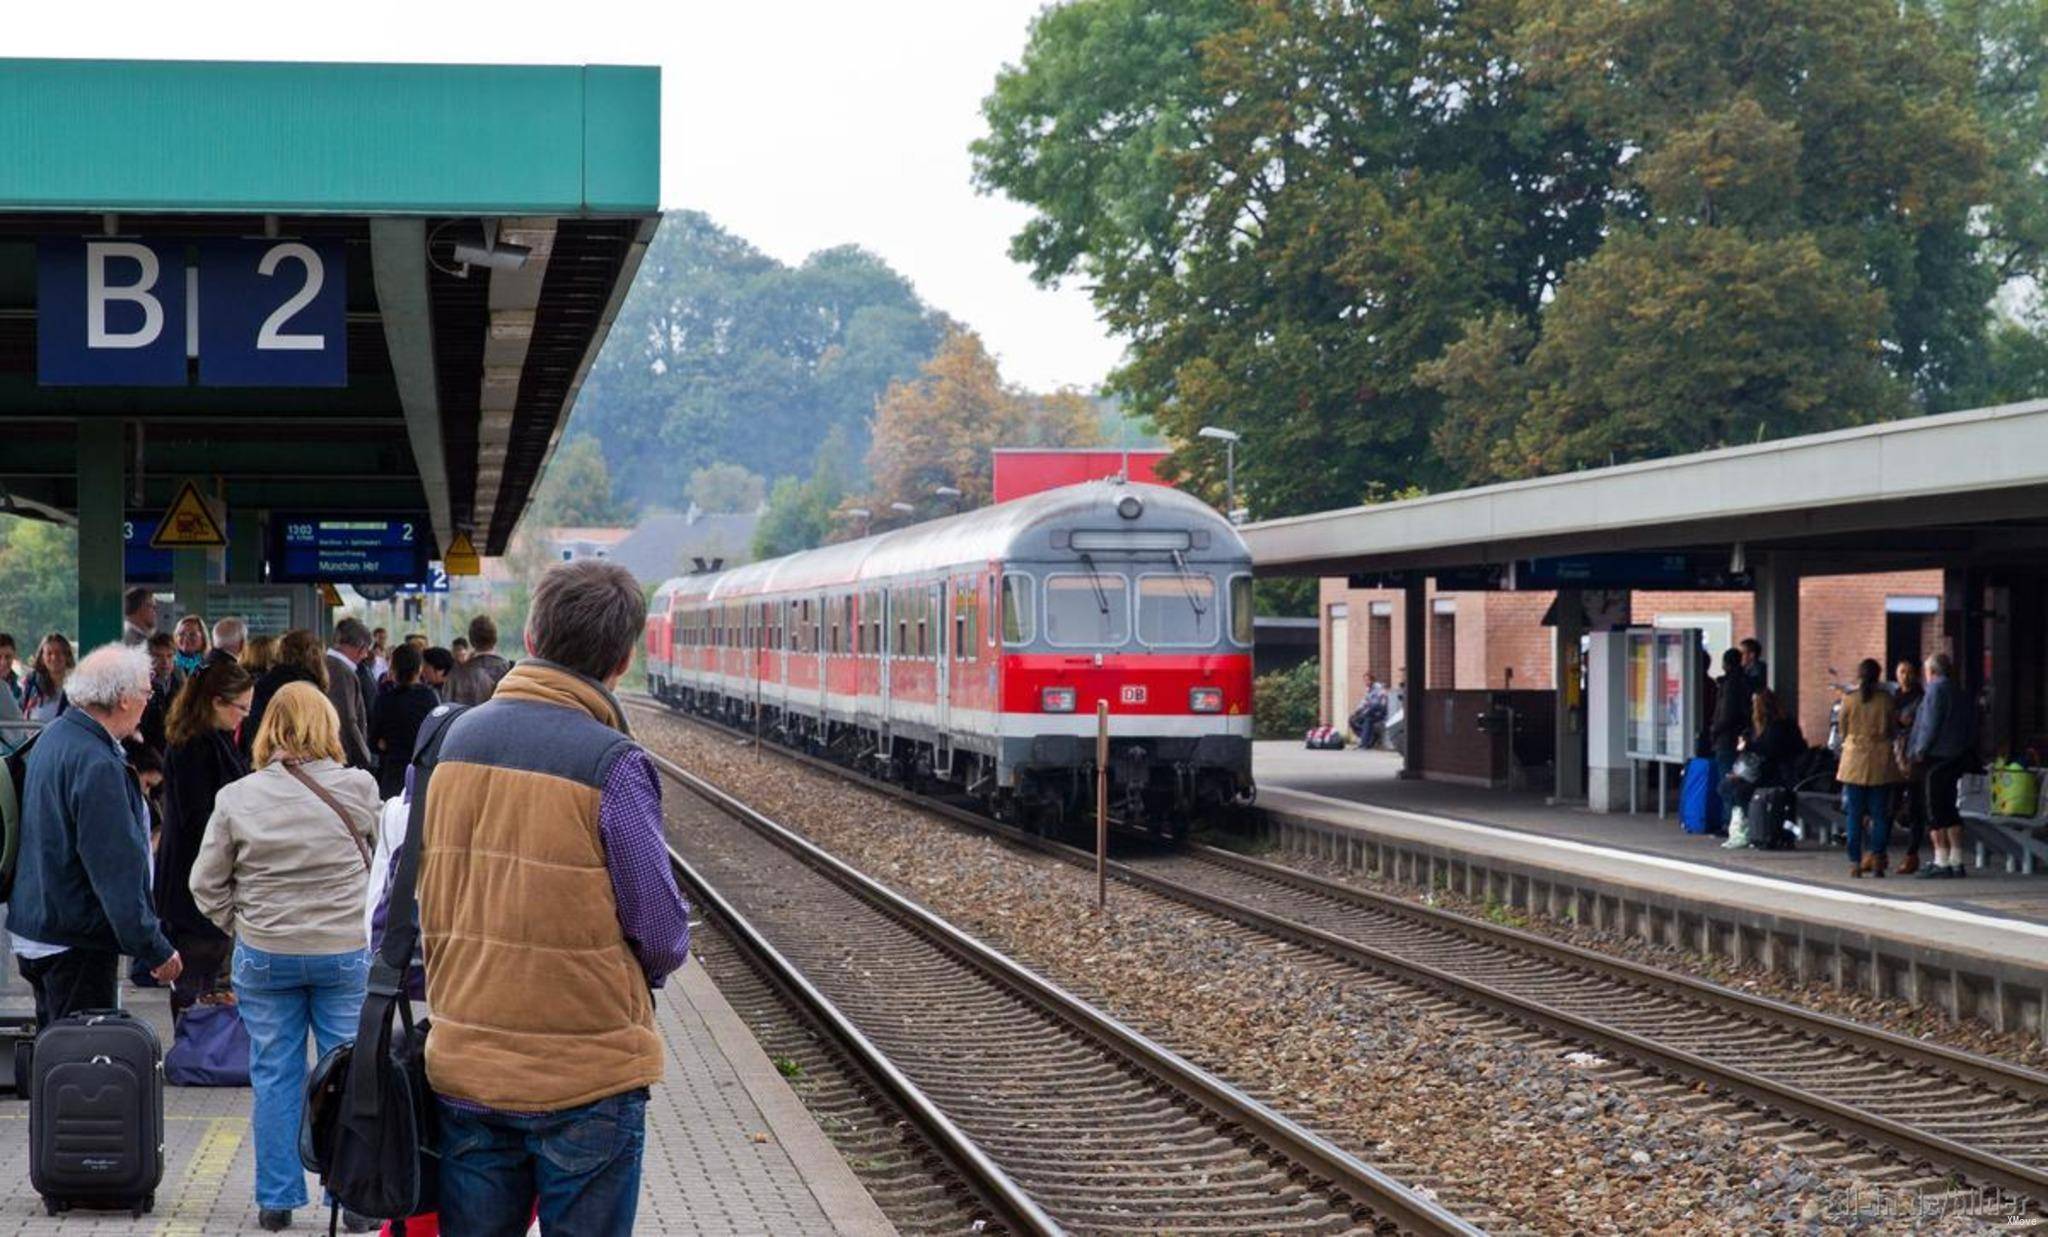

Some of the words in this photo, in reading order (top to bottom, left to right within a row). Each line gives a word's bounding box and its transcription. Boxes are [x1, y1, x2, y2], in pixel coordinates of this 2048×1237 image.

[87, 242, 164, 349] B
[256, 243, 325, 350] 2
[123, 521, 134, 540] 3
[402, 522, 414, 541] 2
[434, 569, 447, 588] 2
[1124, 688, 1145, 701] DB
